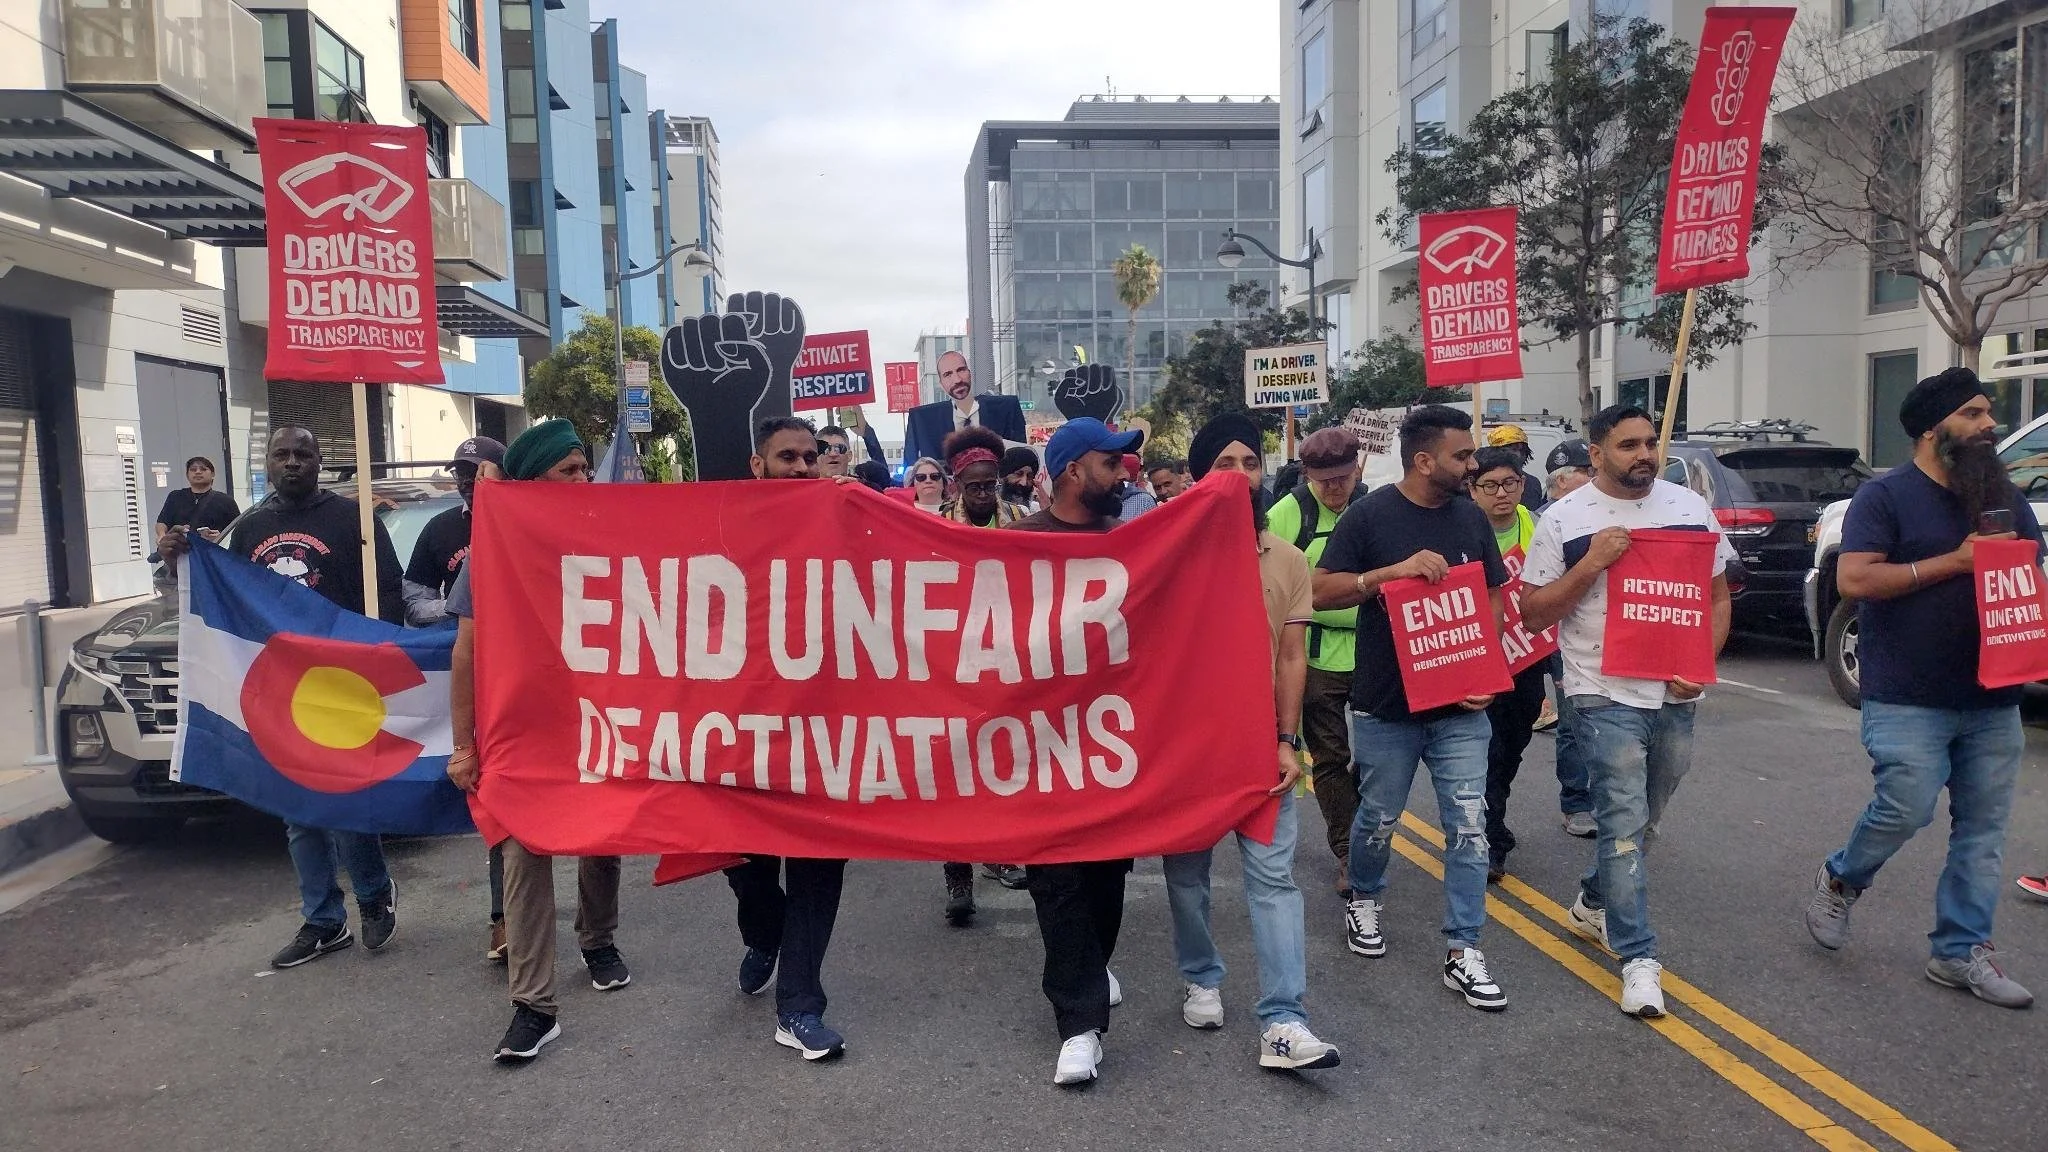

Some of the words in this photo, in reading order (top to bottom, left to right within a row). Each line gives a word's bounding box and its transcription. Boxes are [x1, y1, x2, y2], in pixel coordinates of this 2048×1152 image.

[1681, 136, 1749, 176] DRIVERS
[284, 232, 417, 273] DRIVERS
[286, 278, 420, 318] DEMAND
[1427, 278, 1508, 309] DRIVERS
[287, 324, 425, 348] TRANSPARENCY
[1430, 307, 1510, 339] DEMAND
[1431, 337, 1513, 360] TRANSPARENCY
[1253, 356, 1269, 371] I'M
[1271, 357, 1279, 369] A
[1281, 354, 1318, 369] DRIVER.
[793, 372, 866, 398] RESPECT
[1257, 376, 1260, 387] I
[1262, 373, 1309, 387] DESERVE
[1310, 371, 1316, 383] A
[1254, 391, 1291, 405] LIVING
[1292, 388, 1320, 401] WAGE.
[1360, 417, 1365, 425] A
[1623, 578, 1702, 600] ACTIVATE
[1984, 564, 2037, 603] END
[559, 553, 748, 680] END
[768, 556, 1131, 685] UNFAIR
[1401, 586, 1477, 633] END
[1622, 602, 1703, 627] RESPECT
[1985, 603, 2043, 629] UNFAIR
[1408, 622, 1483, 656] UNFAIR
[1412, 645, 1487, 672] DEACTIVATIONS
[577, 693, 1139, 804] DEACTIVATIONS
